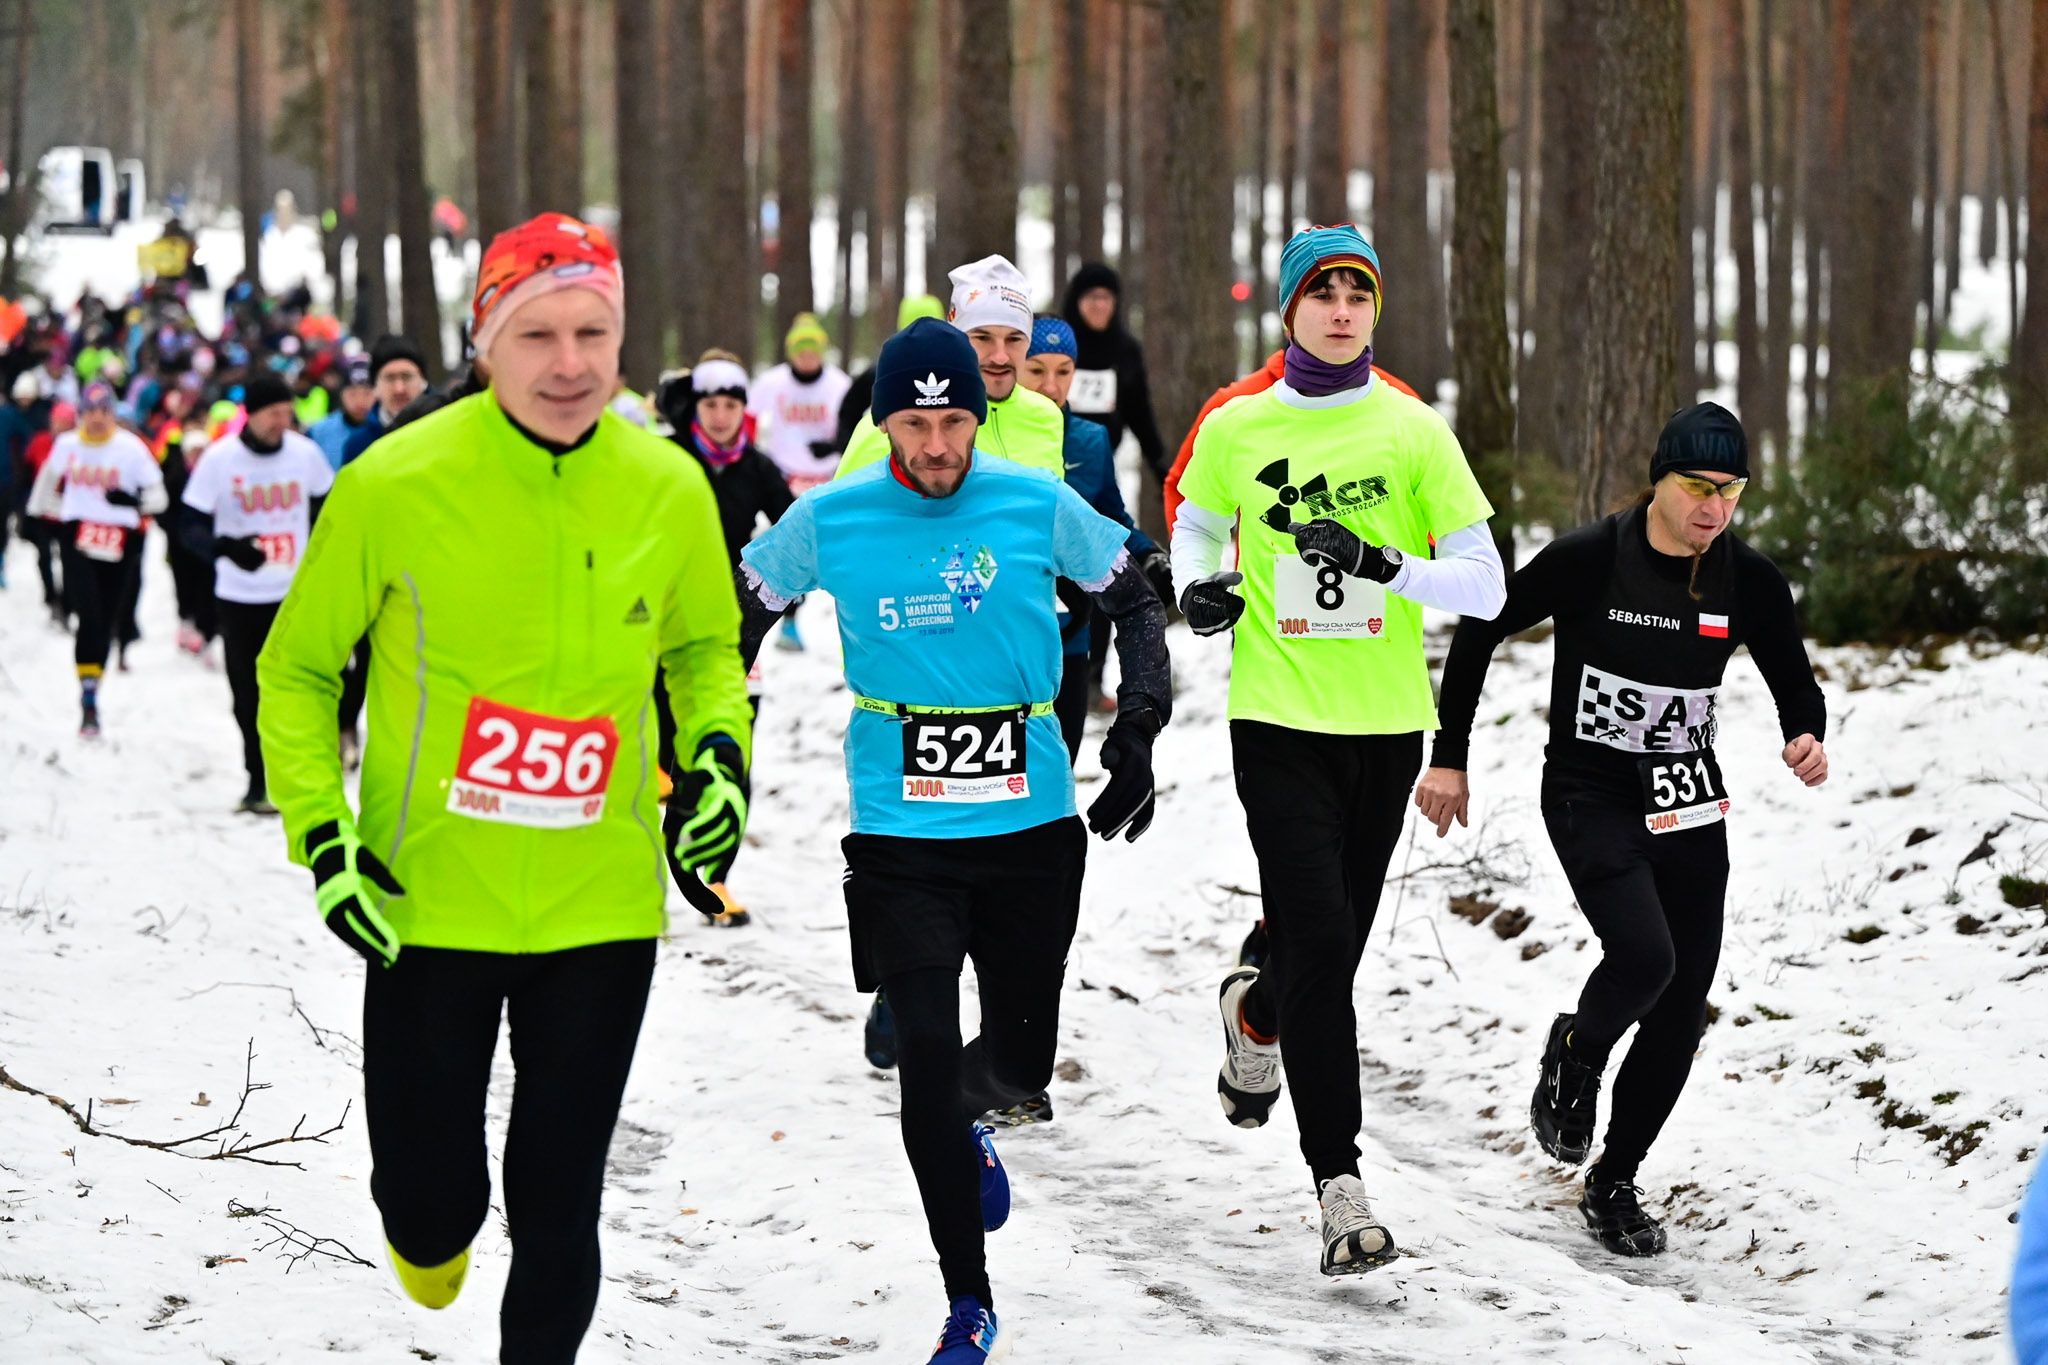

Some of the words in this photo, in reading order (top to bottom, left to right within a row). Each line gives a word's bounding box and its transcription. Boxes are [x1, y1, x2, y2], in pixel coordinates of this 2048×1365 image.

[915, 396, 949, 406] adidas
[1691, 432, 1740, 463] WAY
[1305, 475, 1388, 517] RCR
[1353, 495, 1390, 512] ROZGARTY
[904, 593, 951, 604] SANPROBI
[1316, 565, 1344, 610] 8
[878, 597, 905, 631] 5.
[905, 603, 952, 617] MARATON
[907, 615, 954, 628] SZCZECIŃSKI
[1608, 608, 1681, 631] SEBASTIAN
[864, 701, 885, 712] Enea
[467, 717, 607, 793] 256
[915, 721, 1016, 773] 524
[1652, 757, 1715, 808] 531
